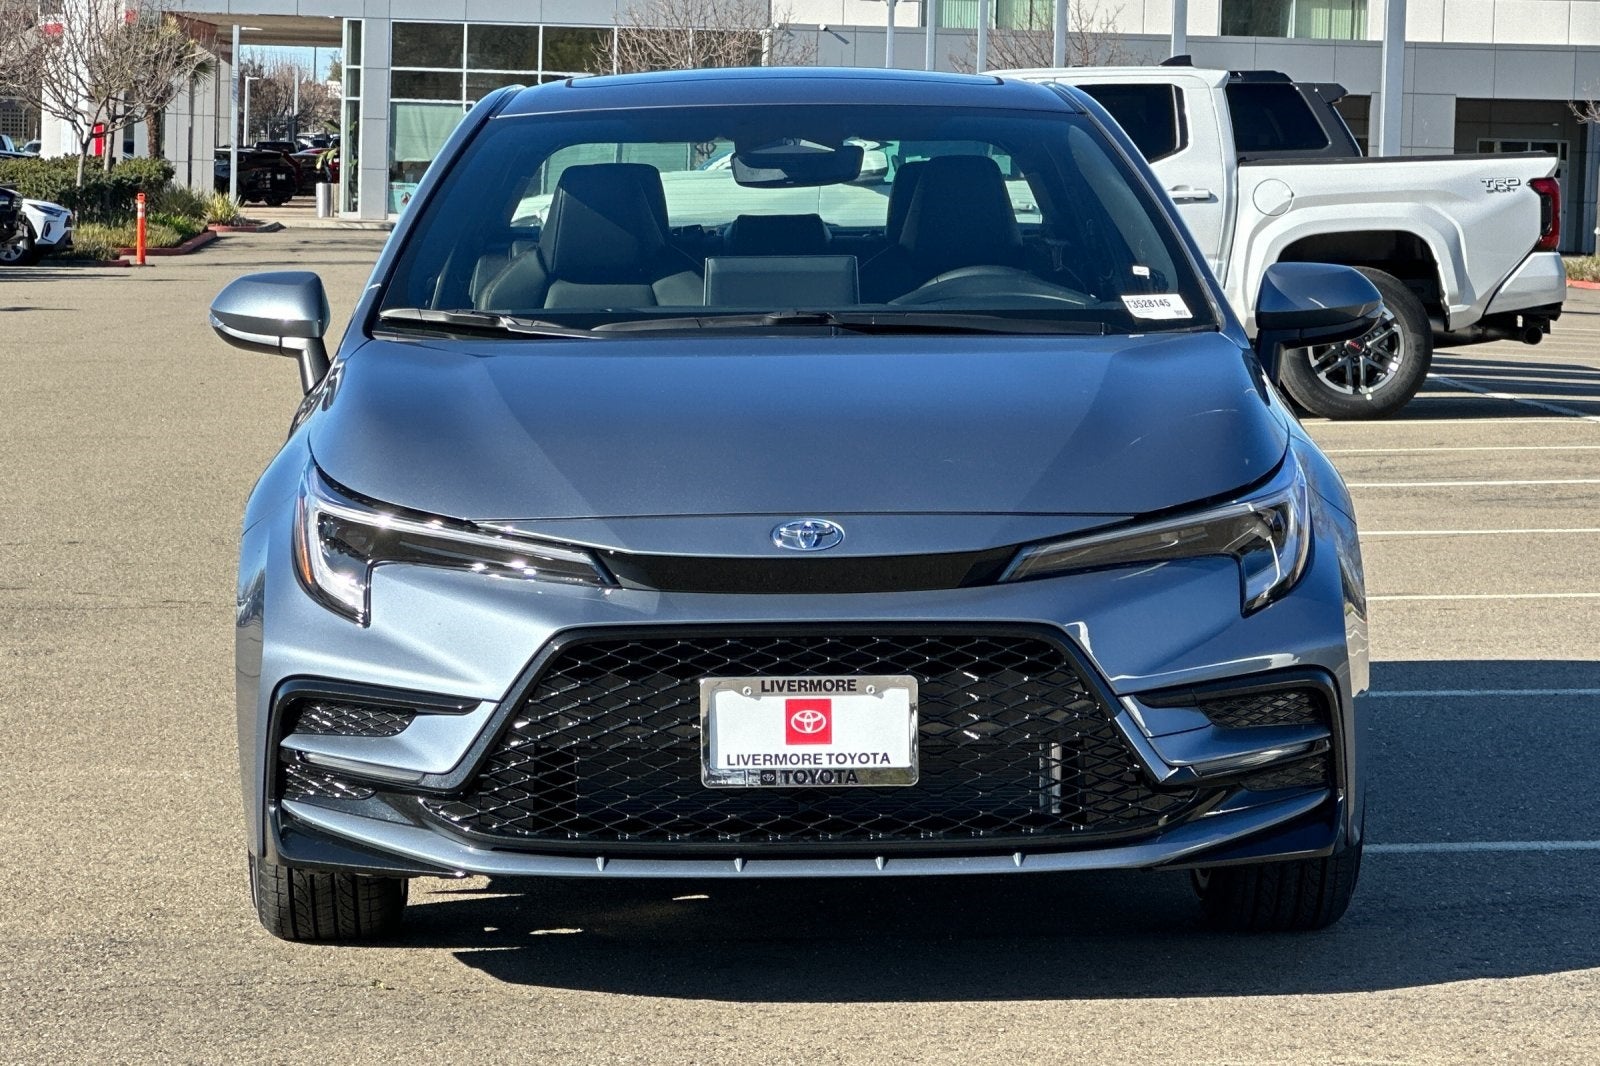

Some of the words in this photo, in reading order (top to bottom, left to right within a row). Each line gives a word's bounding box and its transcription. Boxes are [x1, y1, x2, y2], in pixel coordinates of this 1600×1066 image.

[1482, 178, 1521, 189] TRD
[760, 679, 857, 693] LIVERMORE
[727, 753, 823, 766] LIVERMORE
[826, 752, 891, 765] TOYOTA
[783, 770, 859, 784] TOYOTA
